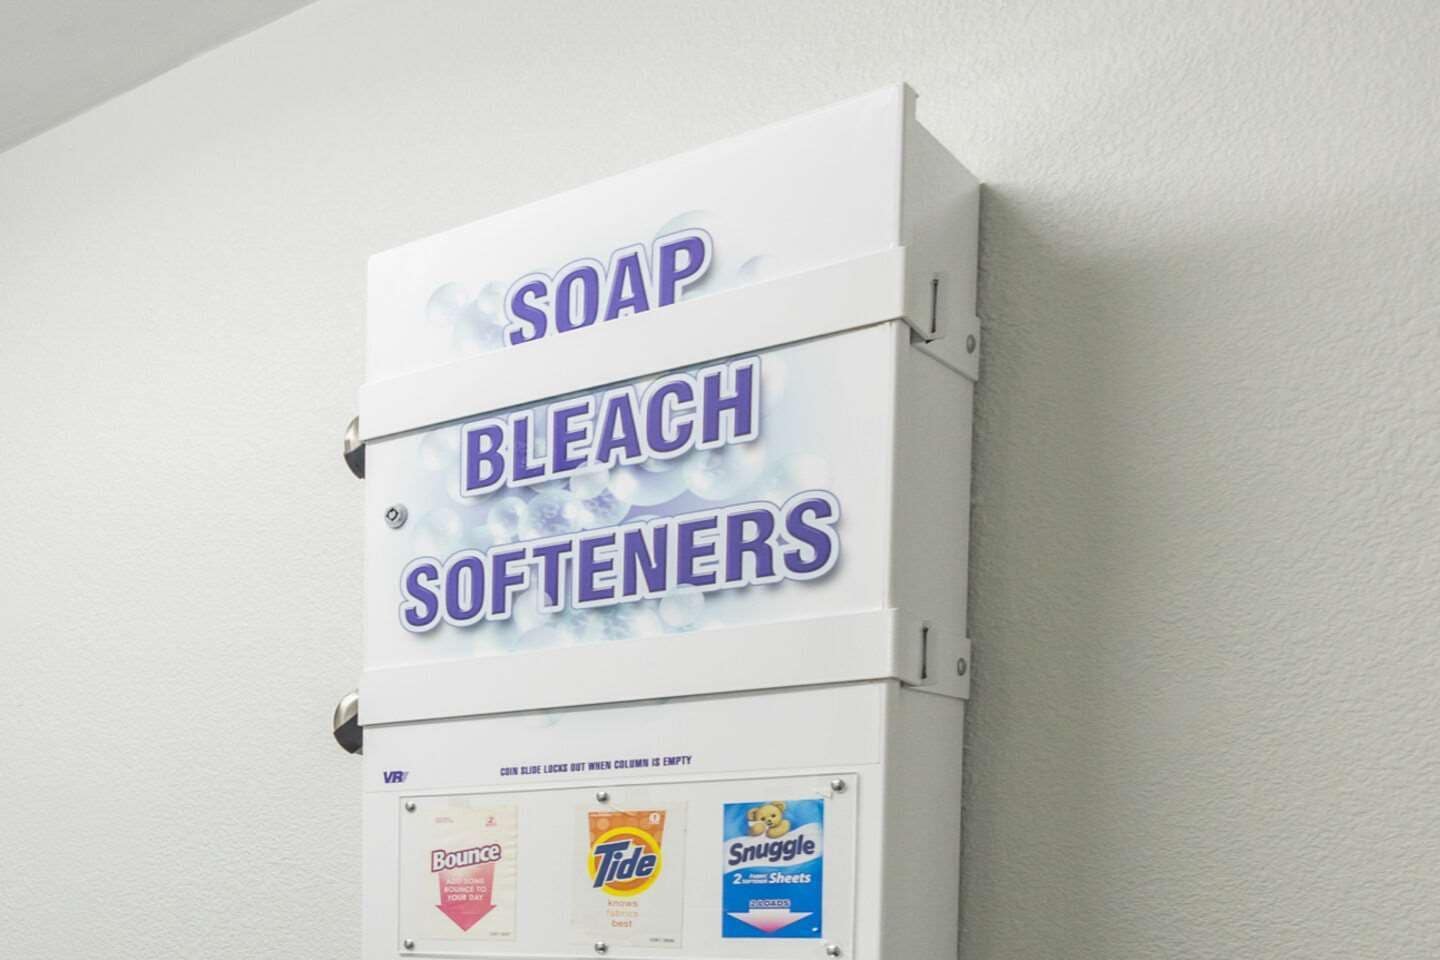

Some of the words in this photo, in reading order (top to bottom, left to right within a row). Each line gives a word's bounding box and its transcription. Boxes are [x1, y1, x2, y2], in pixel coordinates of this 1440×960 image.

[508, 233, 709, 347] SOAP
[464, 362, 755, 493] BLEACH
[403, 496, 834, 627] SOFTENERS
[500, 767, 518, 776] COIN
[521, 765, 541, 775] SLIDE
[544, 764, 567, 774] LOCKS
[570, 763, 585, 772] OUT
[588, 761, 611, 771] WHEN
[614, 758, 649, 770] COLUMN
[652, 757, 660, 767] IS
[663, 755, 692, 767] EMPTY
[431, 843, 503, 873] Bounce
[592, 839, 657, 888] Tide
[728, 834, 815, 866] Snuggle
[732, 873, 743, 885] 2
[769, 871, 812, 884] Sheets
[611, 920, 632, 928] best
